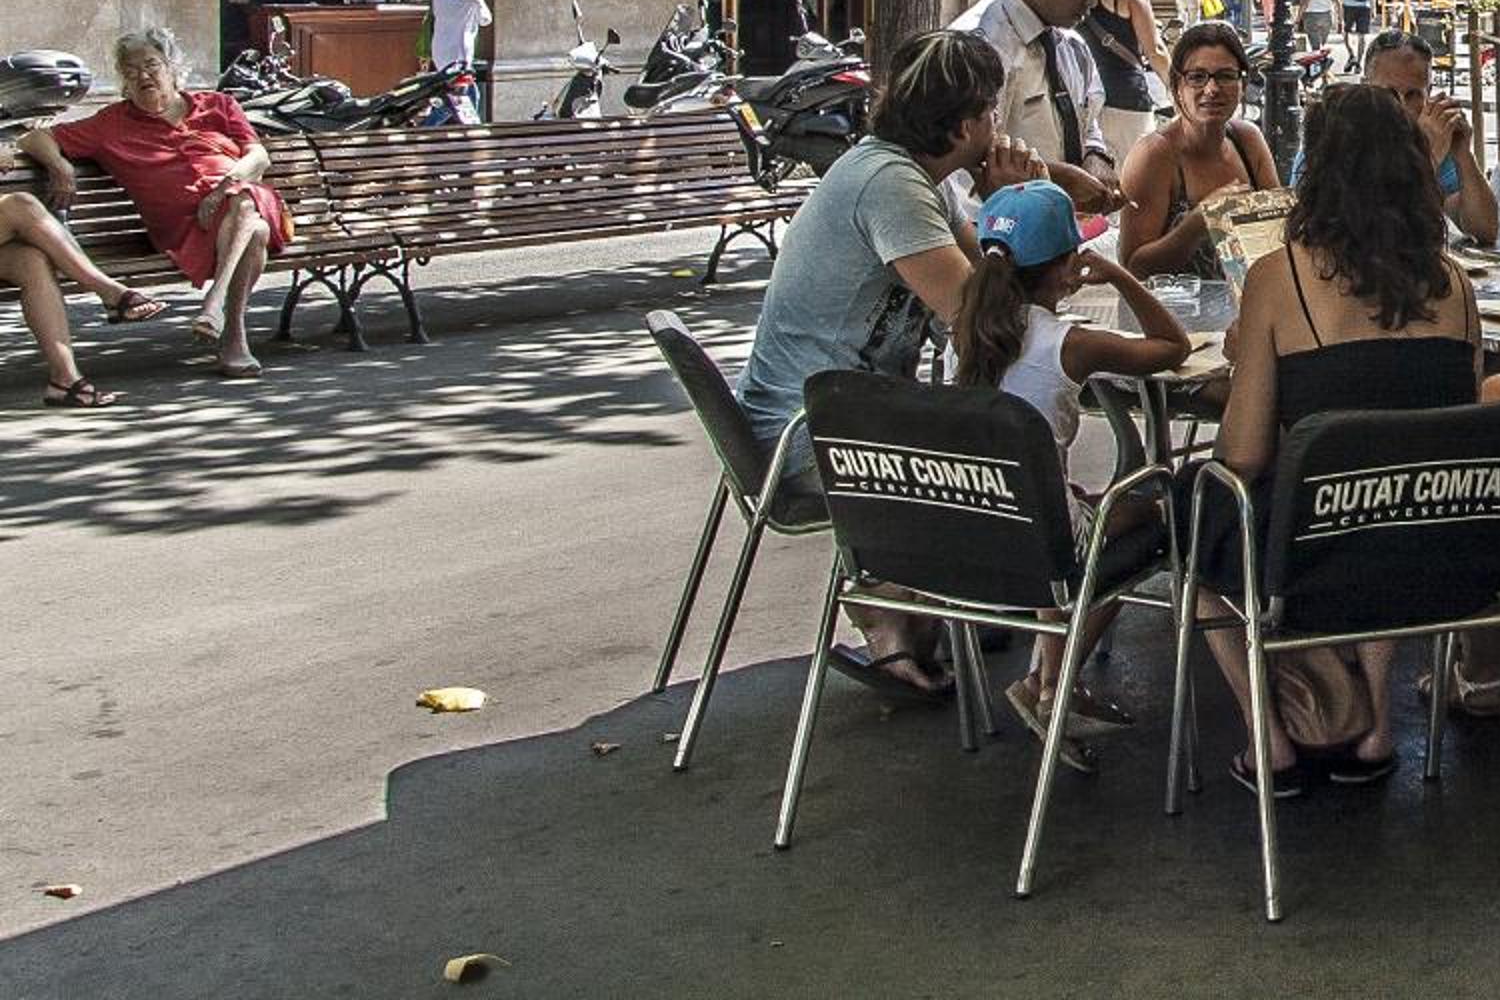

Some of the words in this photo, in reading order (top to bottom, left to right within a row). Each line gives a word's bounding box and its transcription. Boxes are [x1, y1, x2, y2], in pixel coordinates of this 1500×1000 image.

[828, 446, 904, 483] CIUTAT
[909, 456, 1015, 500] COMTAL
[859, 481, 991, 508] CERVESERIA
[1314, 473, 1410, 517] CIUTAT
[1339, 502, 1486, 528] CERVESERIA
